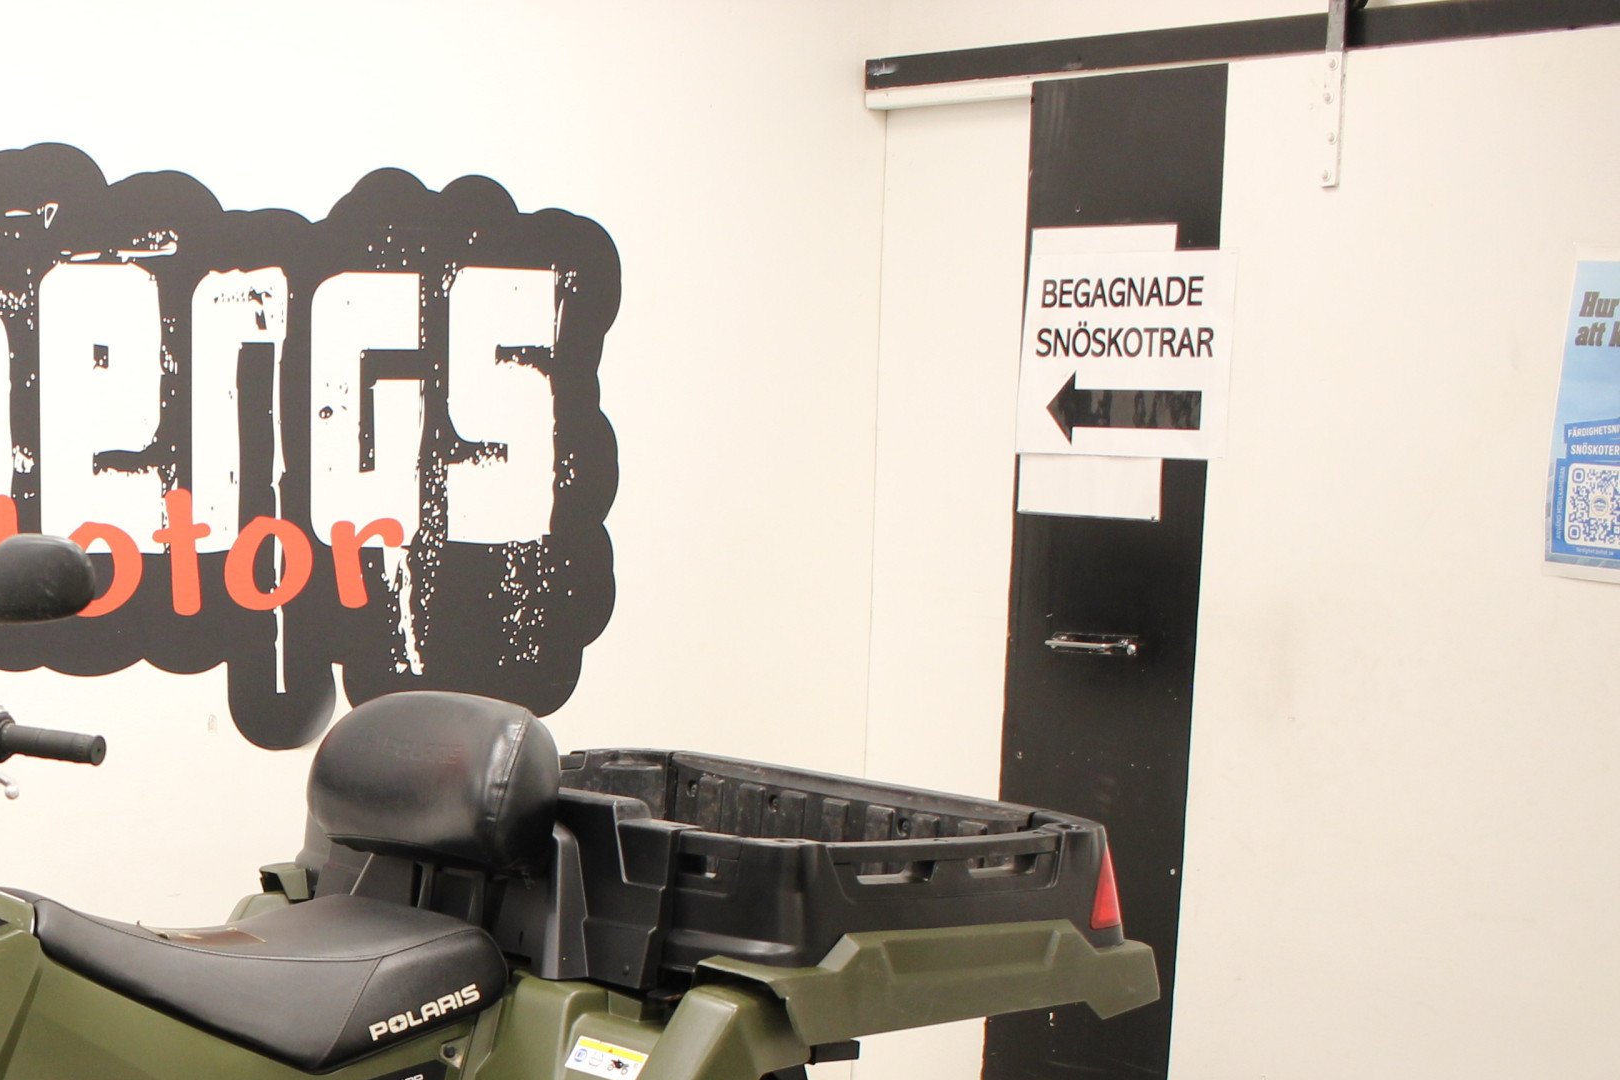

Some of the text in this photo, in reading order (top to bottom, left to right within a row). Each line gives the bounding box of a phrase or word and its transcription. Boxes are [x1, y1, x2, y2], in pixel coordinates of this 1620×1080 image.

[1041, 276, 1204, 308] BEGAGNADE
[1579, 291, 1620, 318] Hur
[1036, 320, 1214, 357] SNÖSKOTRAR
[1575, 321, 1606, 346] att
[368, 983, 481, 1042] POLARIS
